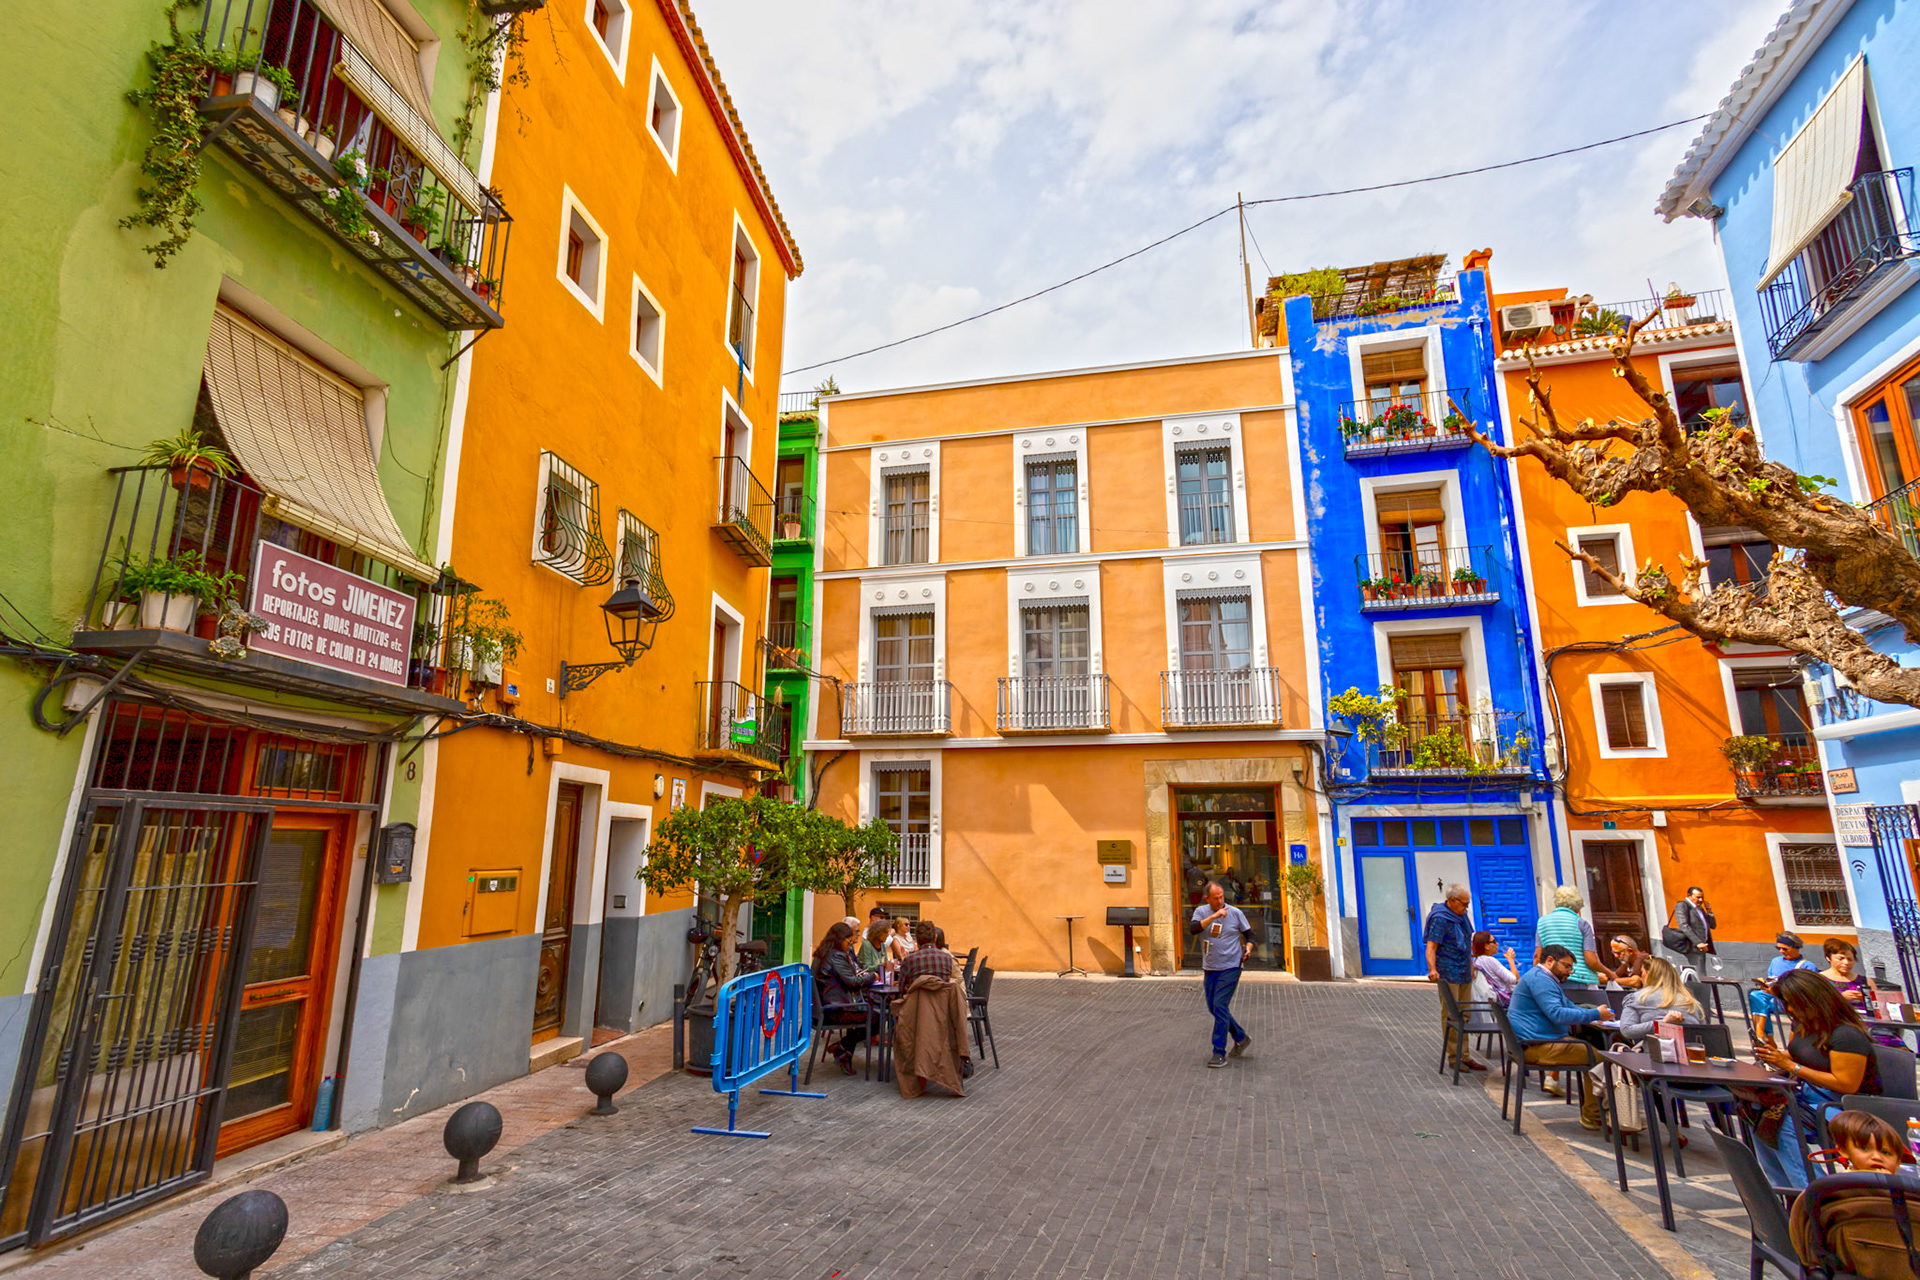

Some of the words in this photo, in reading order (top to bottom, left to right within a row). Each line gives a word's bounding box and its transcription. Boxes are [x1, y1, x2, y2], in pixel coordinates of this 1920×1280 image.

[272, 559, 336, 607] fotos
[341, 584, 406, 630] JIMENEZ
[283, 627, 314, 651] FOTOS
[316, 638, 327, 655] DE
[329, 640, 354, 662] COLOR
[355, 648, 366, 665] EN
[367, 651, 378, 669] 24
[379, 653, 403, 676] HORAS
[353, 622, 390, 649] BAUTIZOS
[390, 639, 403, 653] etc.
[407, 761, 416, 780] 8
